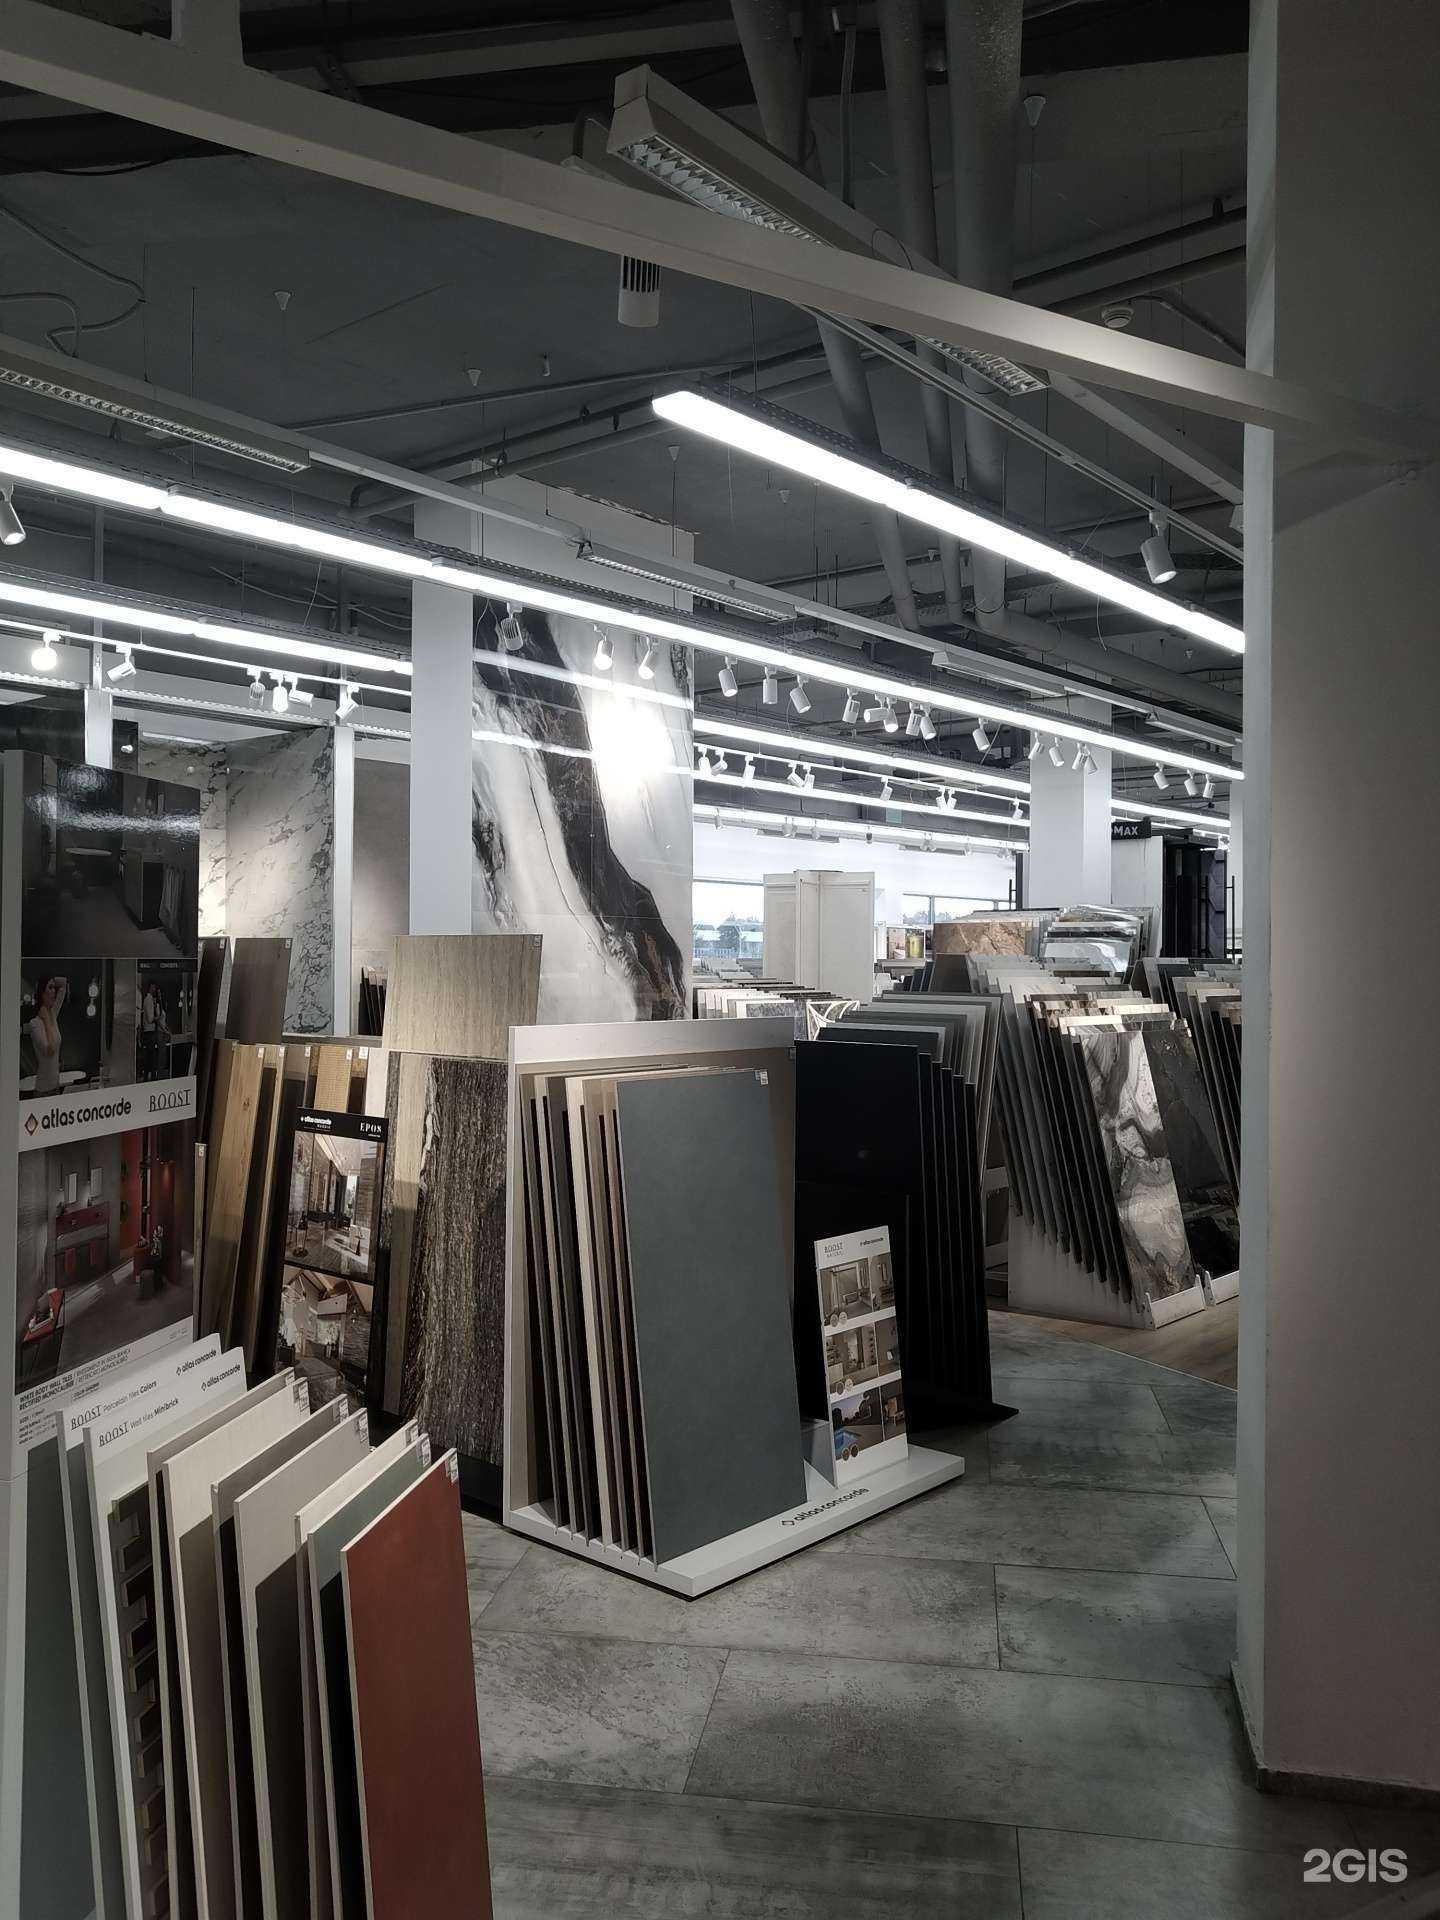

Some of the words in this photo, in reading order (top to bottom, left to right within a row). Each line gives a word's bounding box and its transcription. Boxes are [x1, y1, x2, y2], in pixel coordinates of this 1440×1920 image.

[41, 1107, 75, 1129] atlas
[77, 1098, 132, 1123] concorde
[148, 1089, 192, 1112] BOOST
[360, 1122, 382, 1133] EPOS
[71, 1404, 102, 1431] BOOST
[140, 1380, 157, 1394] Colors
[98, 1421, 129, 1448] BOOST
[154, 1397, 179, 1416] Minibrick
[794, 1504, 824, 1521] atlas
[823, 1488, 870, 1509] concorde
